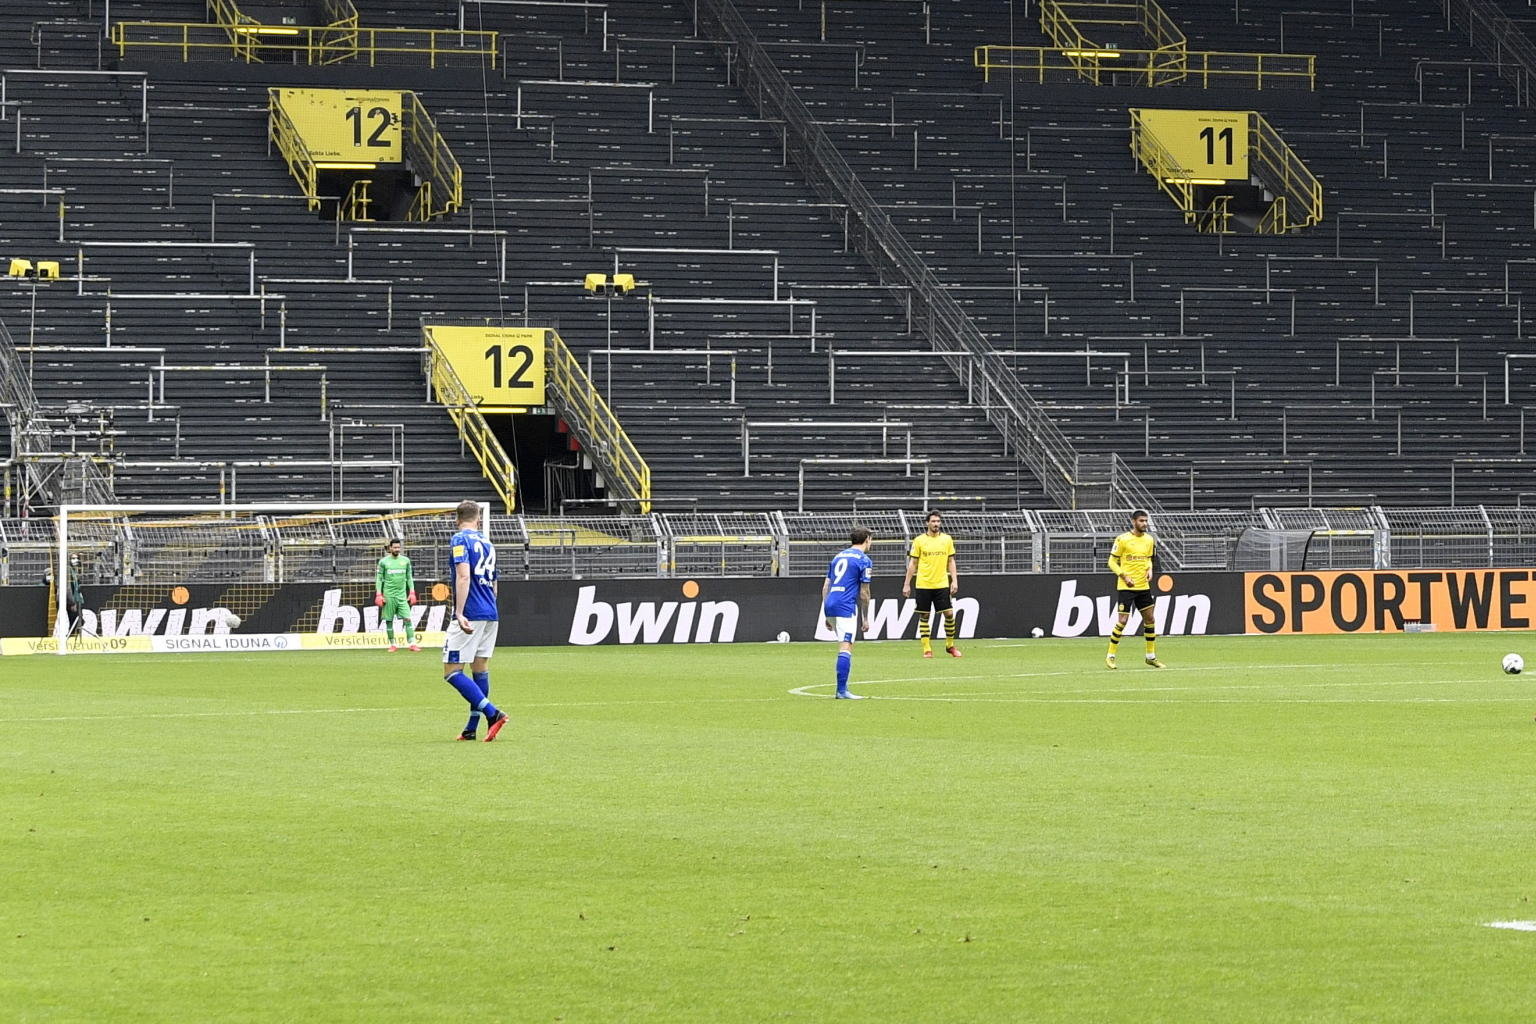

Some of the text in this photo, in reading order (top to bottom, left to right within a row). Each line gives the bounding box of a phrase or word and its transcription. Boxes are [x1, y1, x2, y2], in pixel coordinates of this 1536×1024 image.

[345, 106, 392, 148] 12
[1200, 126, 1233, 165] 11
[484, 344, 534, 389] 12
[473, 541, 497, 580] 24
[834, 558, 848, 585] 9
[568, 580, 740, 645] bwin
[166, 638, 222, 649] SIGNAL
[225, 637, 270, 648] IDUNA
